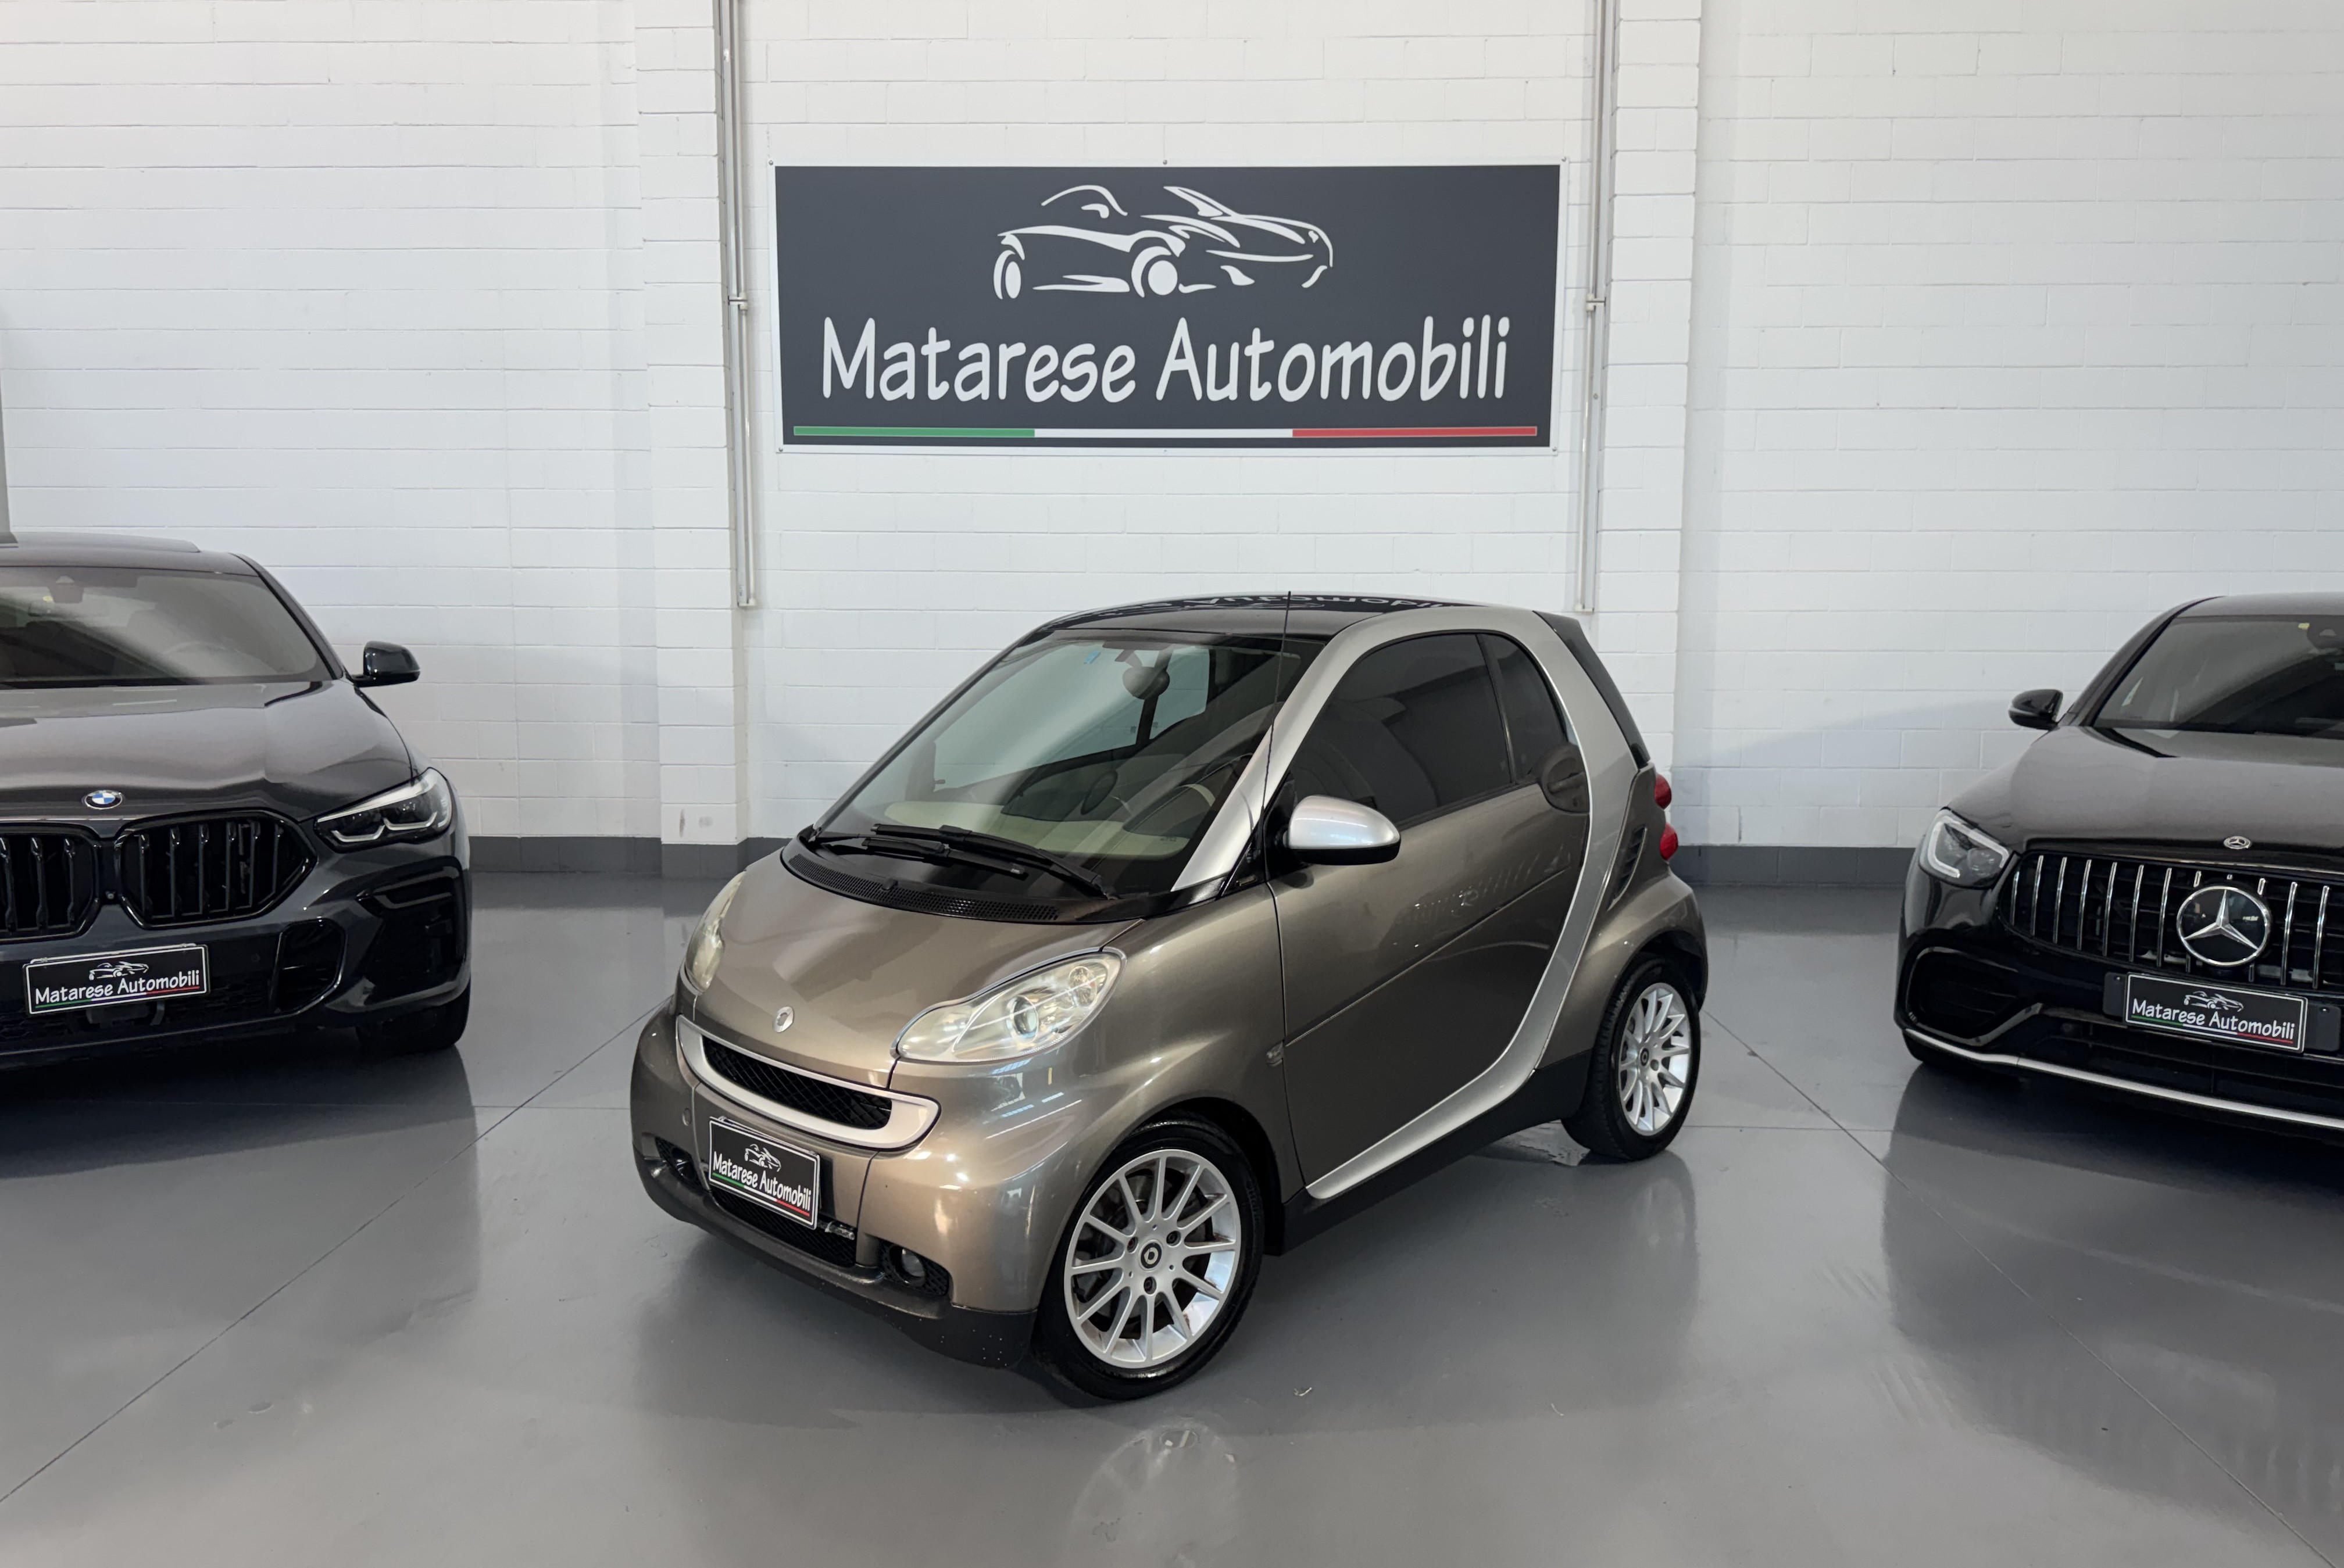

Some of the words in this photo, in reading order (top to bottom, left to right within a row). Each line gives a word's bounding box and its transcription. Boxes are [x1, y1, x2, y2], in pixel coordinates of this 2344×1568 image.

[823, 317, 1136, 403] Matarese
[1156, 314, 1510, 402] Automobili
[35, 984, 113, 1004] Matarese
[117, 969, 199, 994] Automobili
[2132, 998, 2206, 1026] Matarese
[2209, 1011, 2295, 1040] Automobili
[713, 1151, 759, 1188] Matarese
[759, 1170, 812, 1211] Automobili
